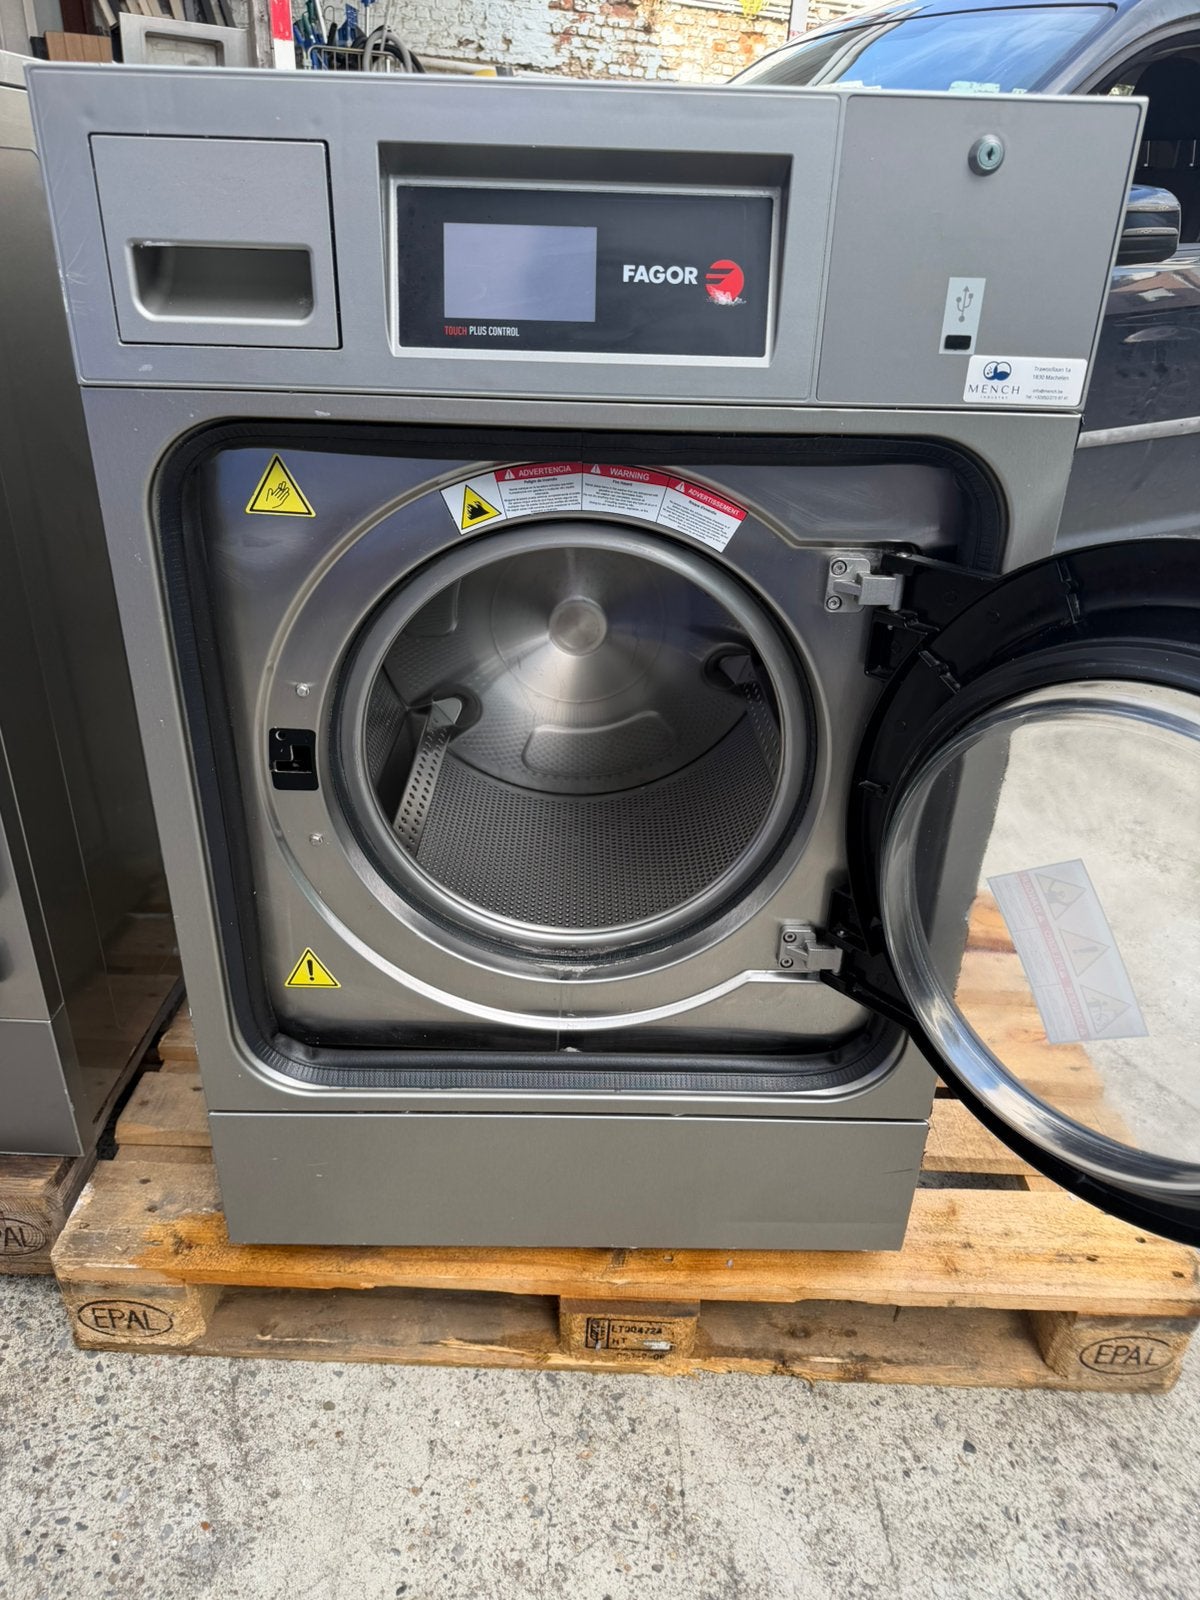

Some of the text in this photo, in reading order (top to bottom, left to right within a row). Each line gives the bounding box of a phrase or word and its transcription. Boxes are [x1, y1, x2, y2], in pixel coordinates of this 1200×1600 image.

[623, 264, 698, 285] FAGOR
[444, 325, 520, 337] TOUCH PLUS CONTROL
[968, 384, 1021, 395] MENCH
[518, 465, 572, 478] ADVERTENCIA
[609, 467, 650, 481] WARNING
[687, 488, 741, 516] ADVERTISSEMENT
[0, 1226, 37, 1248] AL
[92, 1307, 161, 1331] EPAL
[1094, 1344, 1159, 1366] EPAL
